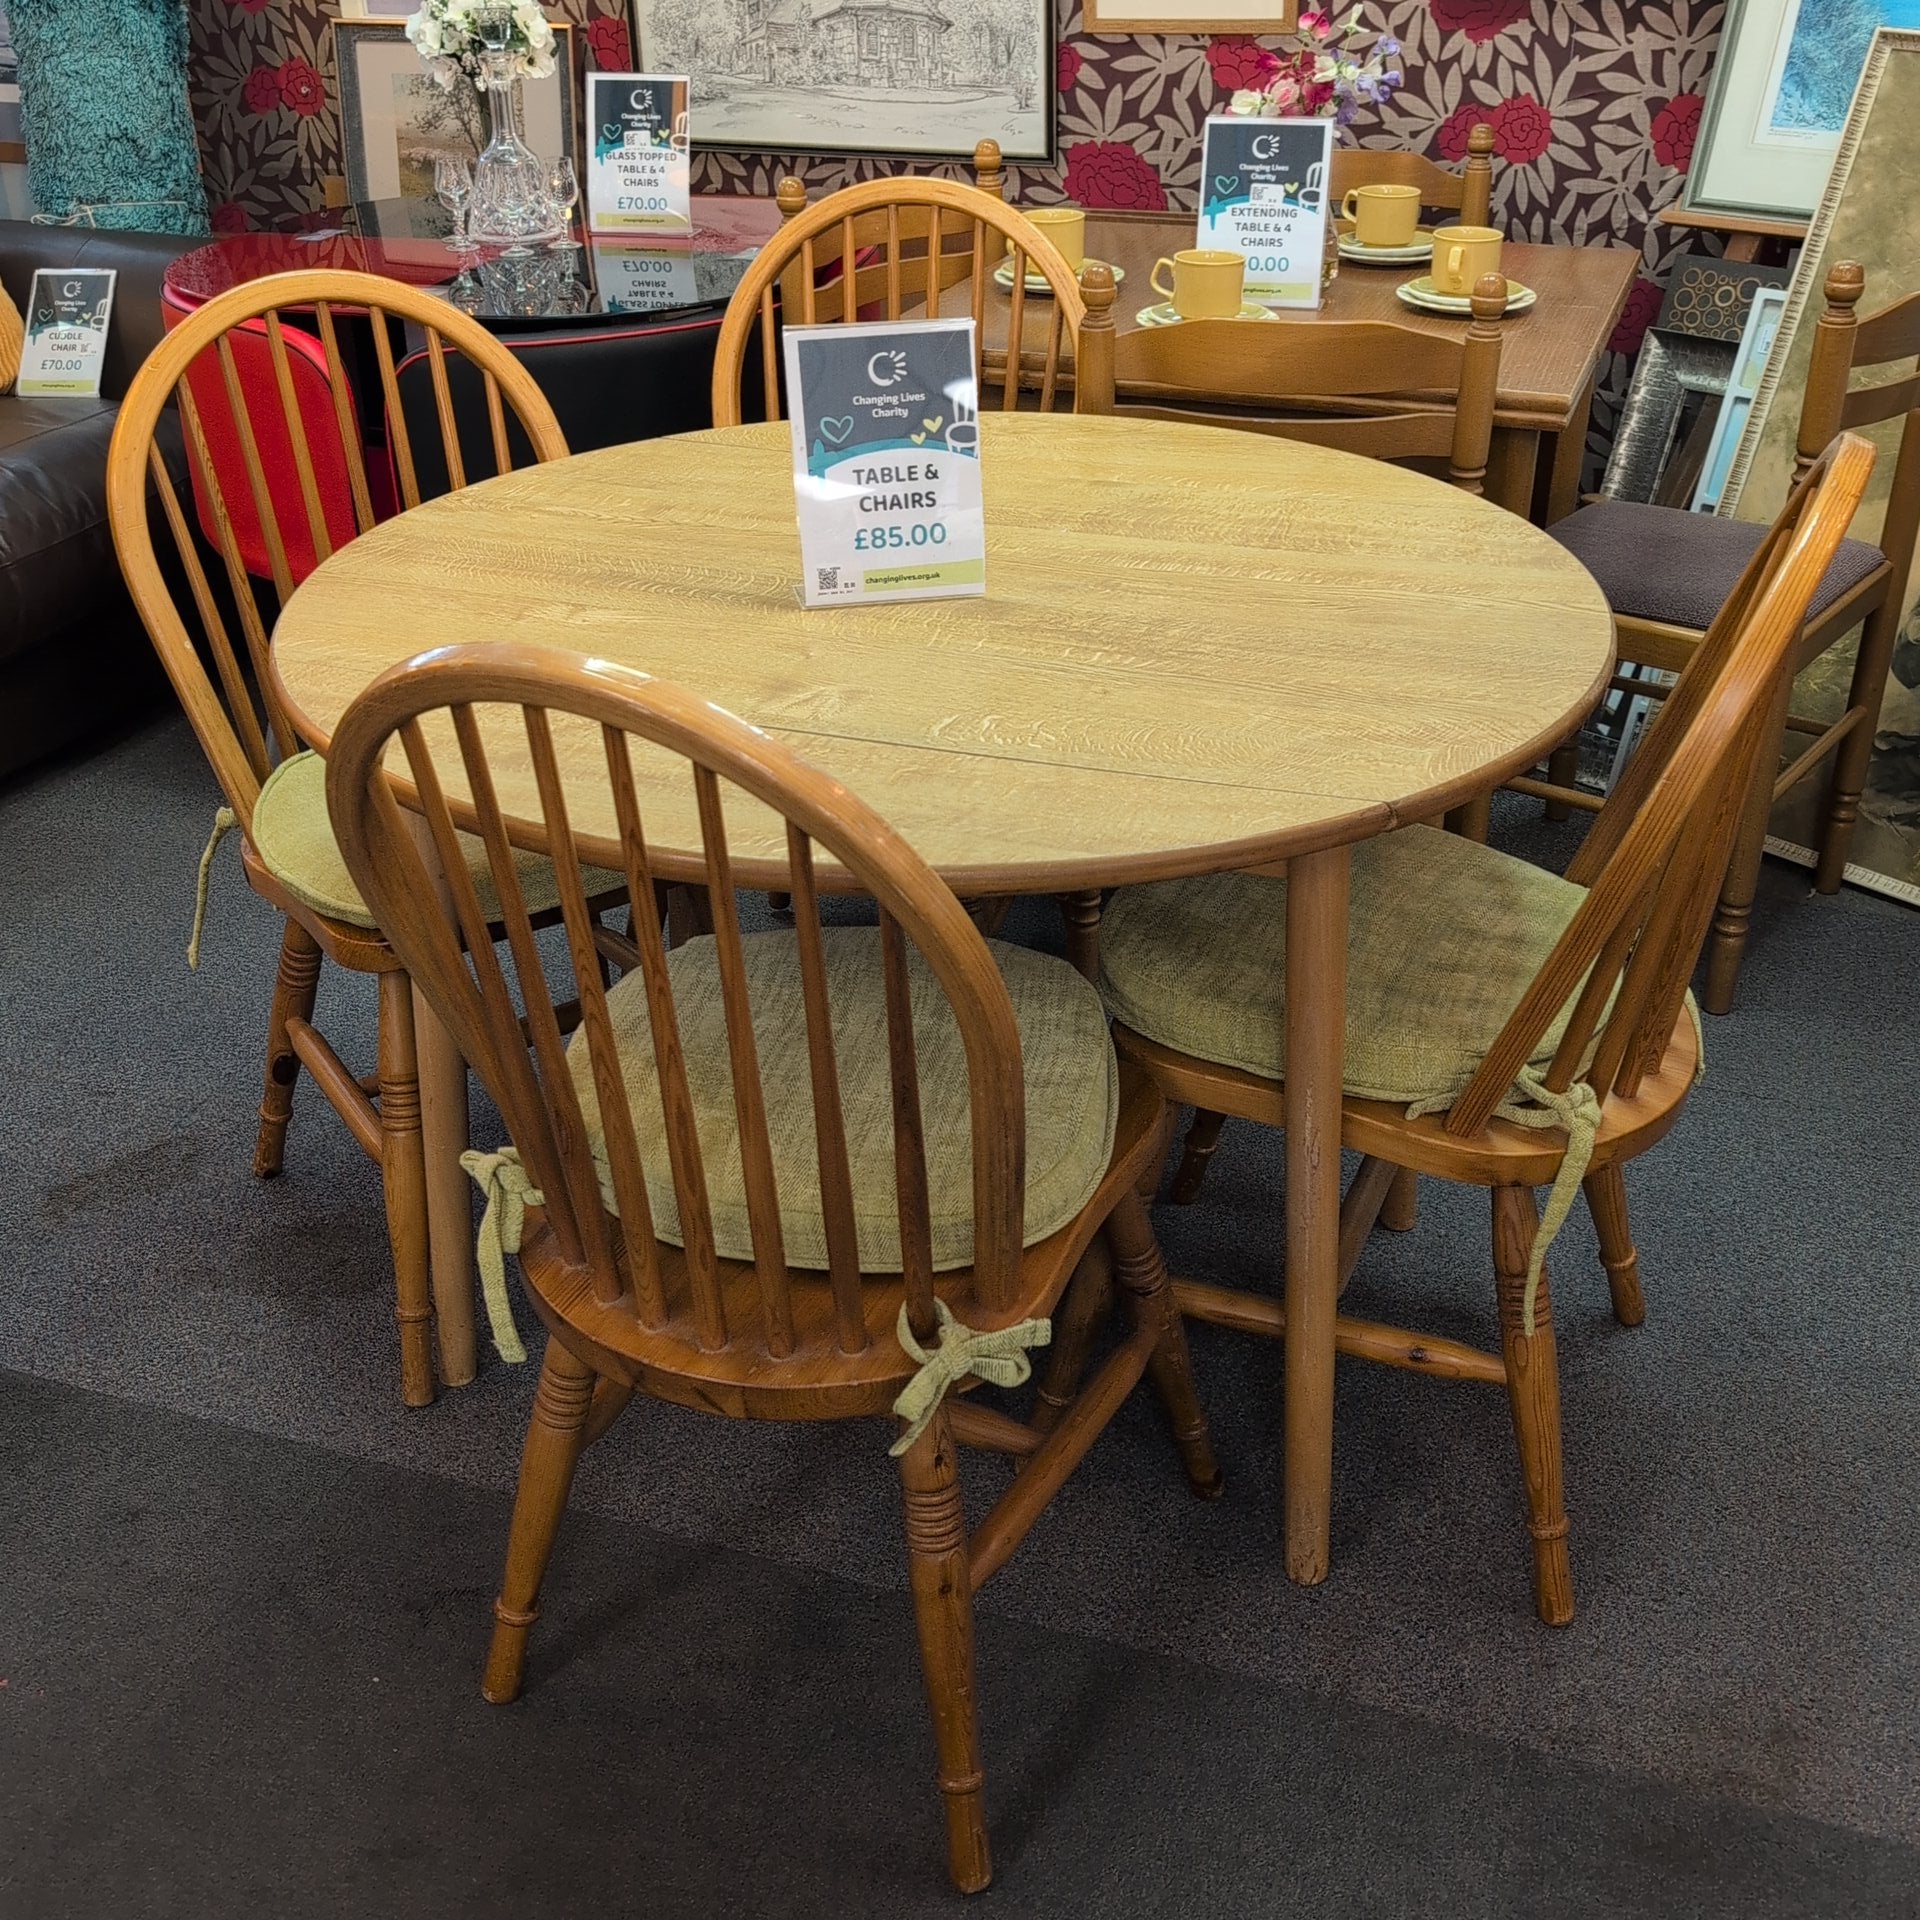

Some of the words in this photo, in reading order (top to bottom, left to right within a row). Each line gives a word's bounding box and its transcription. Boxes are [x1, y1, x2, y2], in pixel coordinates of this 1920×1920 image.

[605, 152, 636, 161] GLASS
[640, 152, 677, 161] TOPPED
[617, 165, 647, 174] TABLE
[649, 165, 657, 174] &
[623, 178, 659, 187] CHAIRS
[1250, 173, 1276, 181] Charity
[618, 197, 668, 210] £70.00
[1231, 207, 1298, 218] EXTENDING
[1235, 222, 1271, 232] TABLE
[1273, 223, 1282, 233] &
[1284, 224, 1291, 232] 4
[1240, 237, 1284, 247] CHAIRS
[1246, 256, 1289, 272] 0.00
[51, 343, 77, 351] CHAIR
[41, 360, 82, 370] £70.00
[852, 393, 899, 406] Changing
[900, 392, 926, 402] Lives
[872, 407, 909, 419] Charity
[852, 465, 919, 486] TABLE
[924, 463, 939, 480] &
[859, 491, 937, 512] CHAIRS
[854, 522, 946, 550] £85.00
[865, 571, 941, 585] changinglives.org.uk
